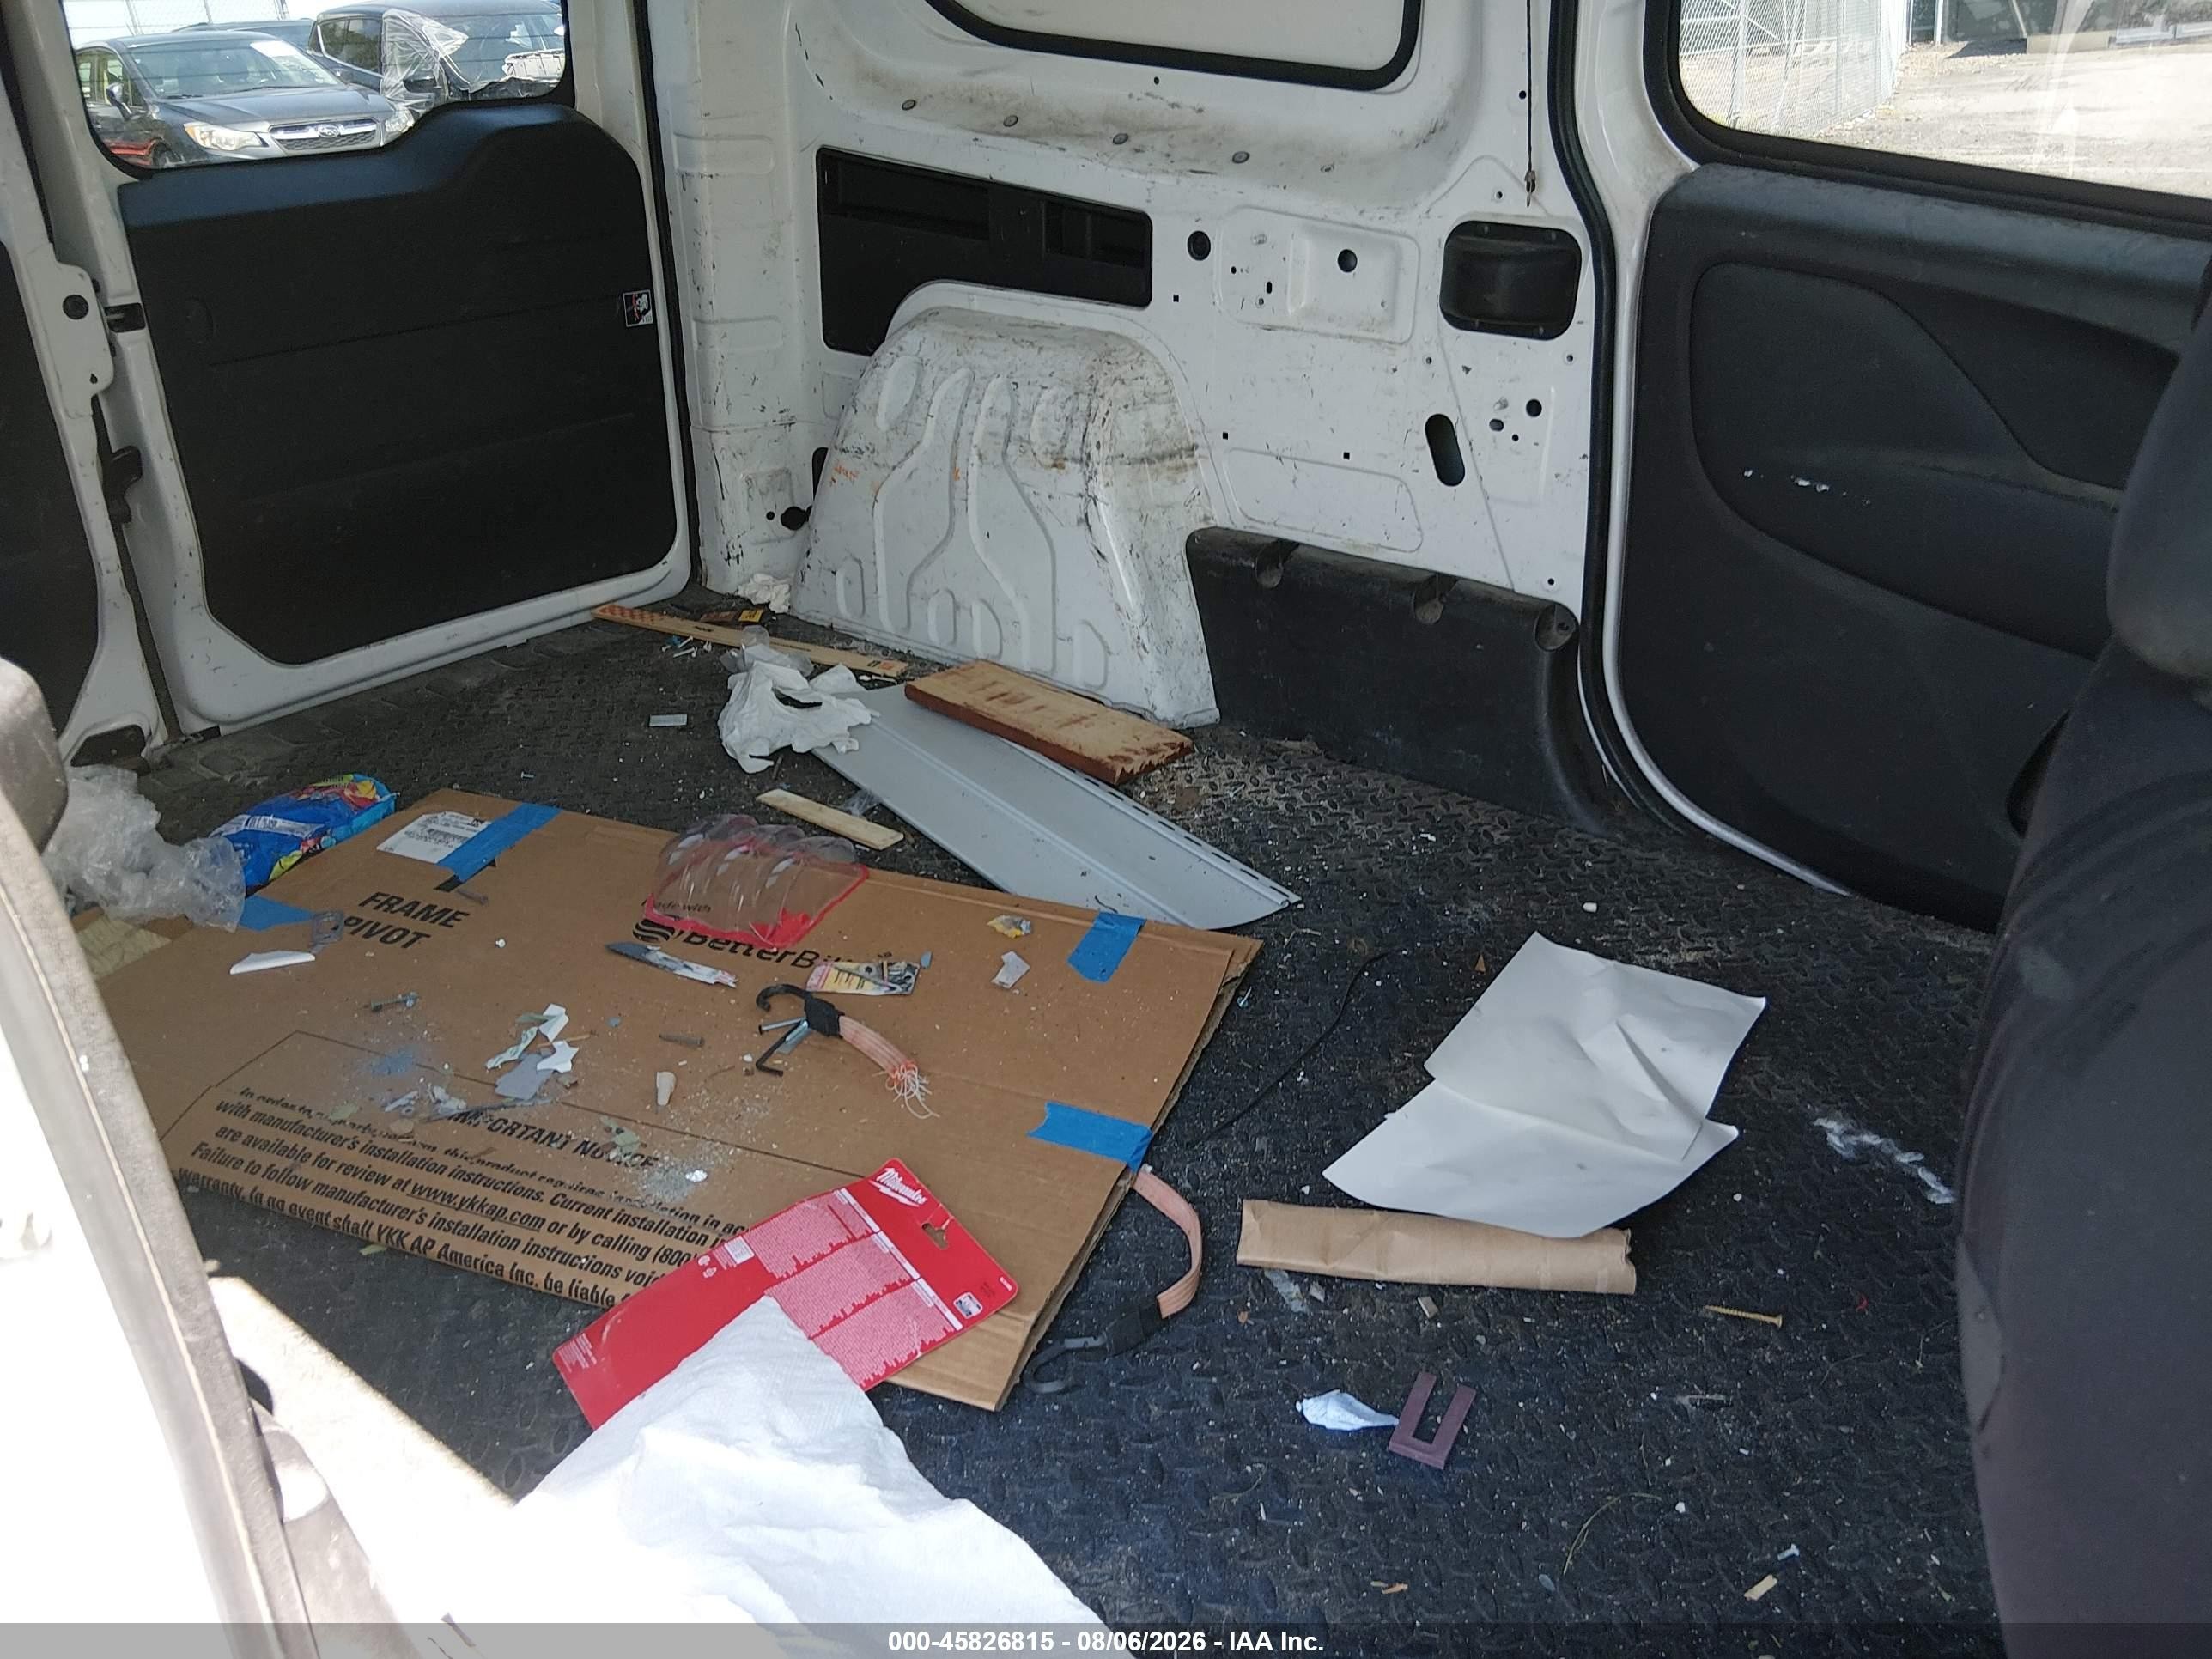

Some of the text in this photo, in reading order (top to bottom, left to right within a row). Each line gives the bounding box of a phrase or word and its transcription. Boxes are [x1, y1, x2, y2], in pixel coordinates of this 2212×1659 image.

[332, 915, 432, 949] PIVOT
[357, 891, 471, 928] FRAME
[178, 1167, 246, 1200] warranty.
[288, 1203, 331, 1224] event
[331, 1213, 375, 1241] shall
[375, 1223, 412, 1250] YKK
[409, 1234, 437, 1256] AP
[435, 1243, 505, 1277] America
[543, 1271, 564, 1294] be
[567, 1278, 617, 1310] liable
[190, 1140, 245, 1171] Failure
[243, 1158, 263, 1176] to
[261, 1164, 313, 1190] follow
[311, 1181, 429, 1226] manufacturer's
[427, 1212, 522, 1251] installation
[520, 1237, 623, 1279] instructions
[215, 1100, 251, 1120] with
[251, 1110, 360, 1151] manufacturer's
[358, 1139, 449, 1176] installation
[447, 1164, 544, 1203] instructions.
[549, 1192, 613, 1220] Current
[611, 1208, 710, 1248] installation
[215, 1126, 243, 1143] are
[241, 1133, 313, 1164] available
[311, 1151, 338, 1171] for
[334, 1161, 392, 1187] review
[391, 1177, 413, 1193] at
[409, 1181, 547, 1231] www.ykkap.com
[546, 1219, 569, 1235] or
[567, 1221, 592, 1245] by
[590, 1231, 653, 1262] calling
